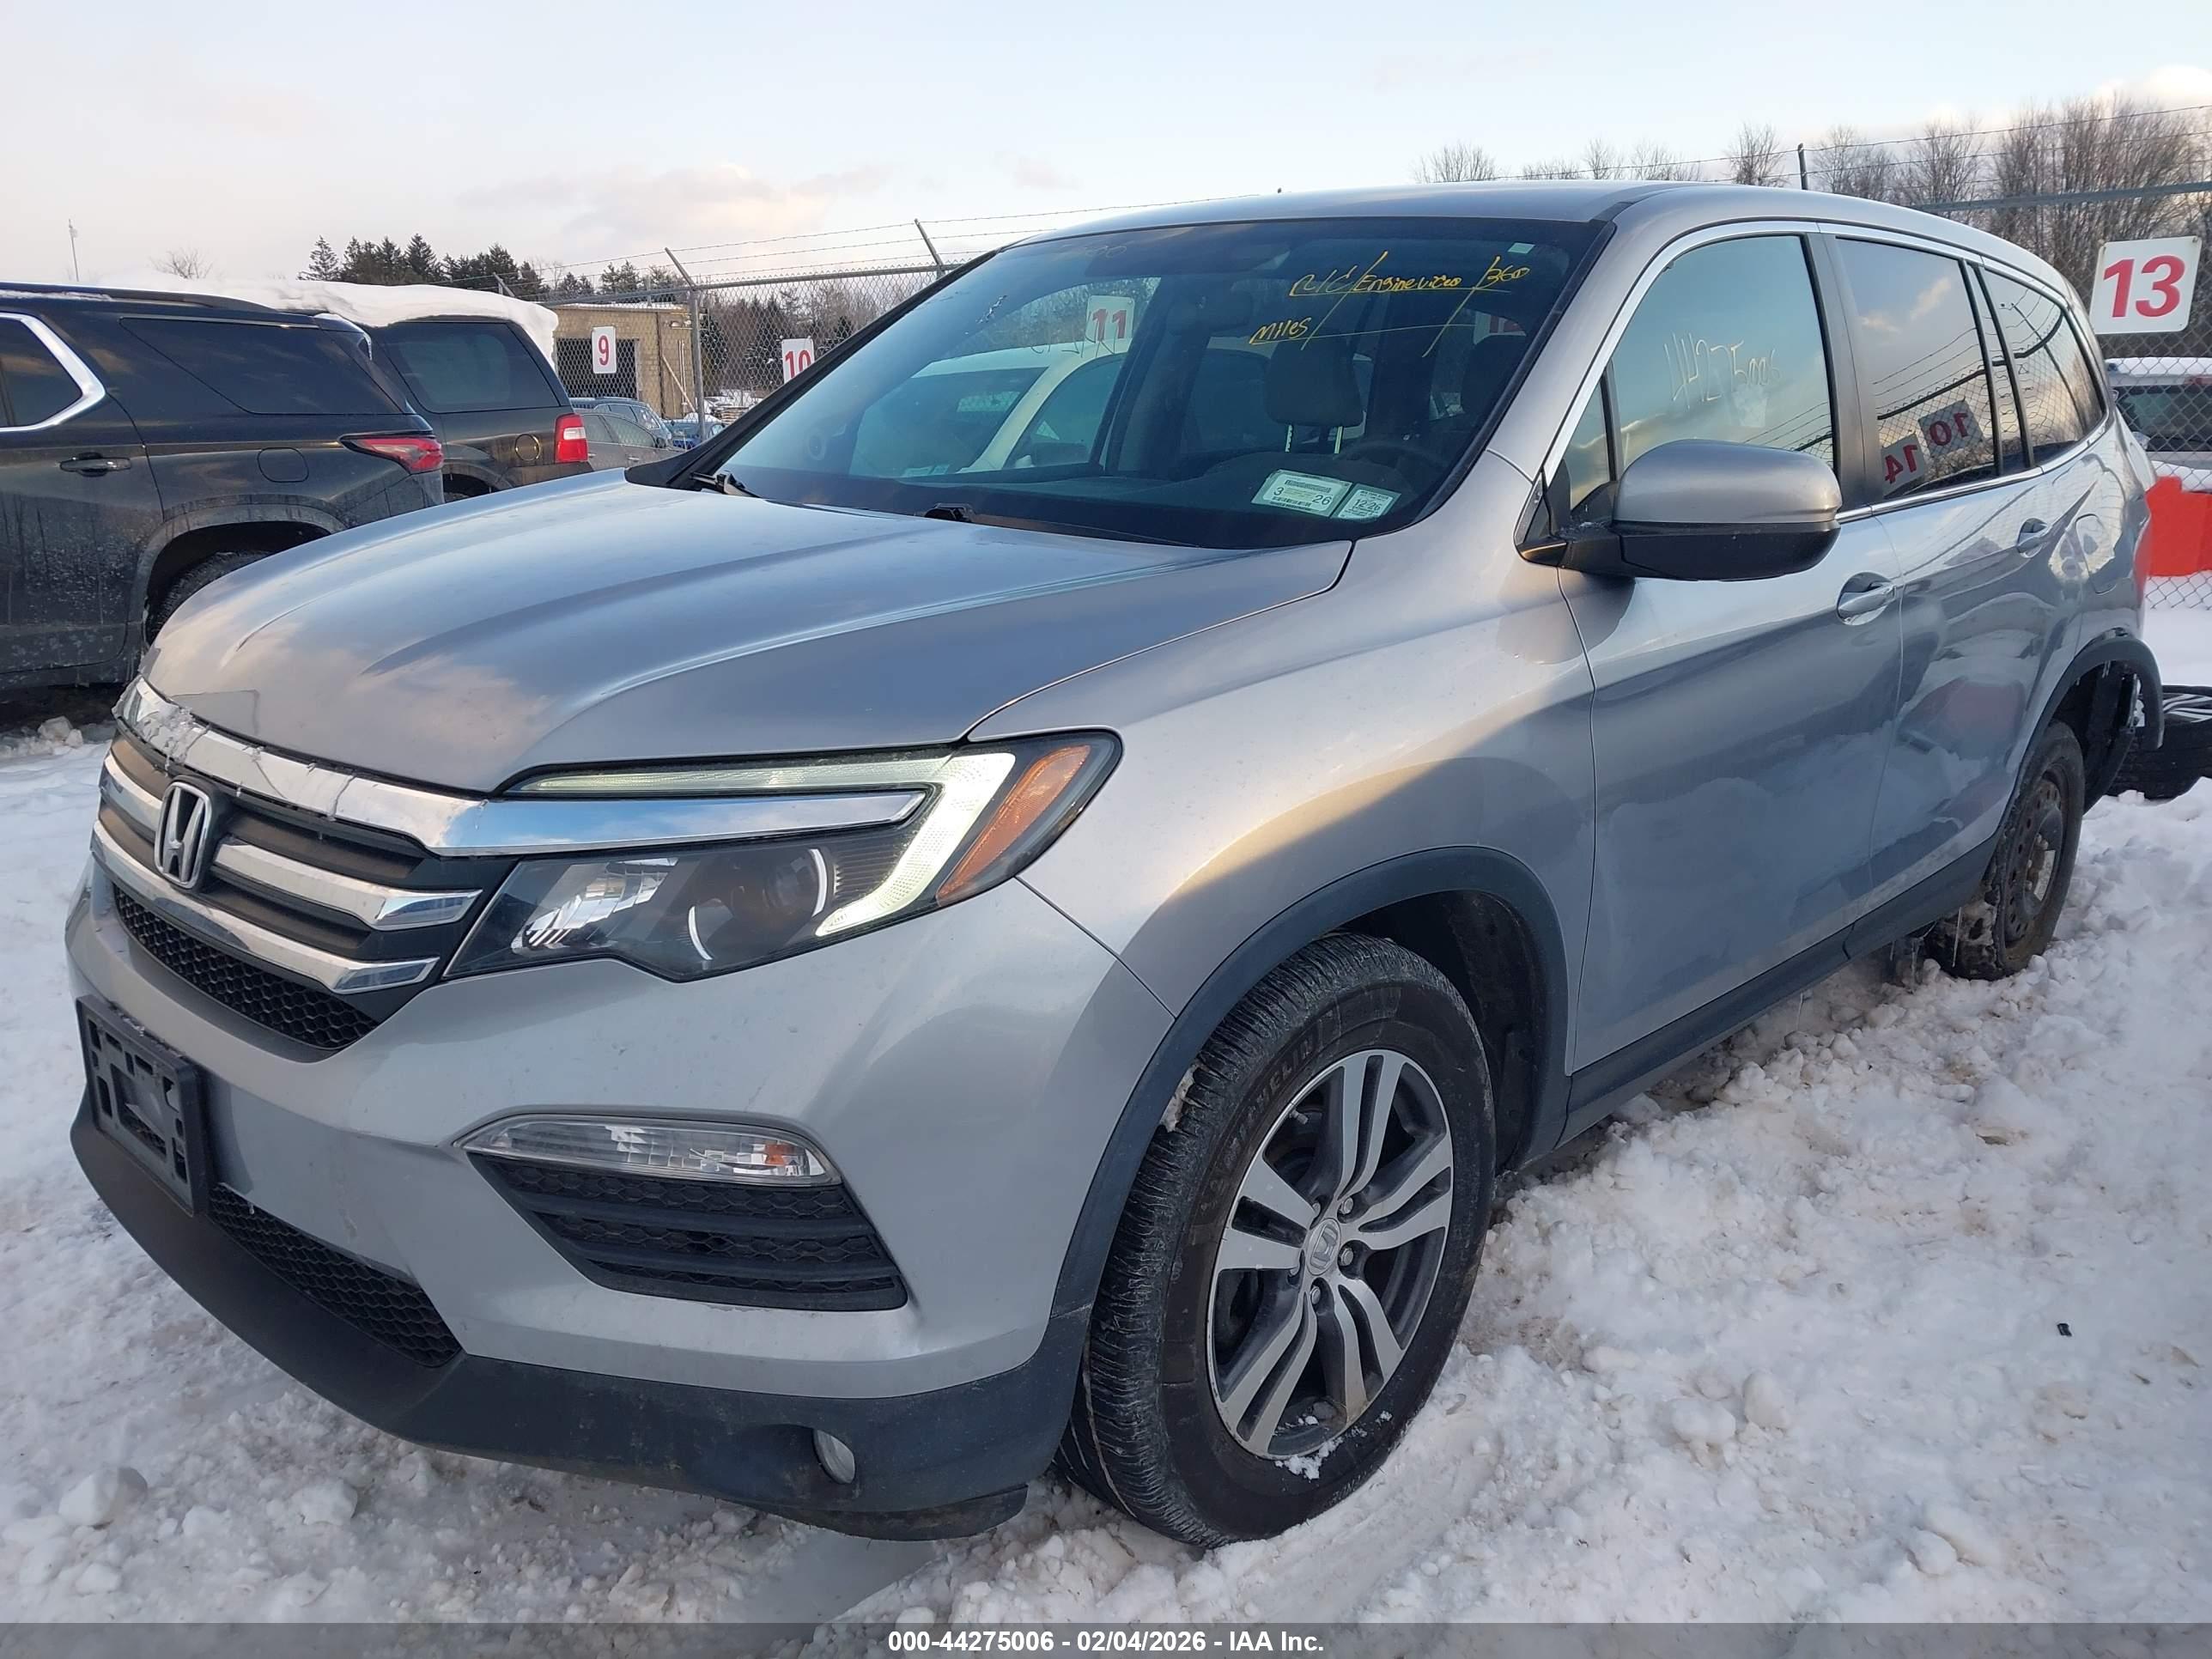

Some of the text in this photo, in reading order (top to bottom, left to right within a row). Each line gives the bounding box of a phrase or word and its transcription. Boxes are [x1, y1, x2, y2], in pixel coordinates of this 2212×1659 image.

[2103, 254, 2186, 318] 13
[1092, 308, 1127, 342] 11
[598, 335, 610, 366] 9
[785, 349, 811, 379] 10
[1273, 486, 1285, 496] 3
[1312, 494, 1333, 506] 26
